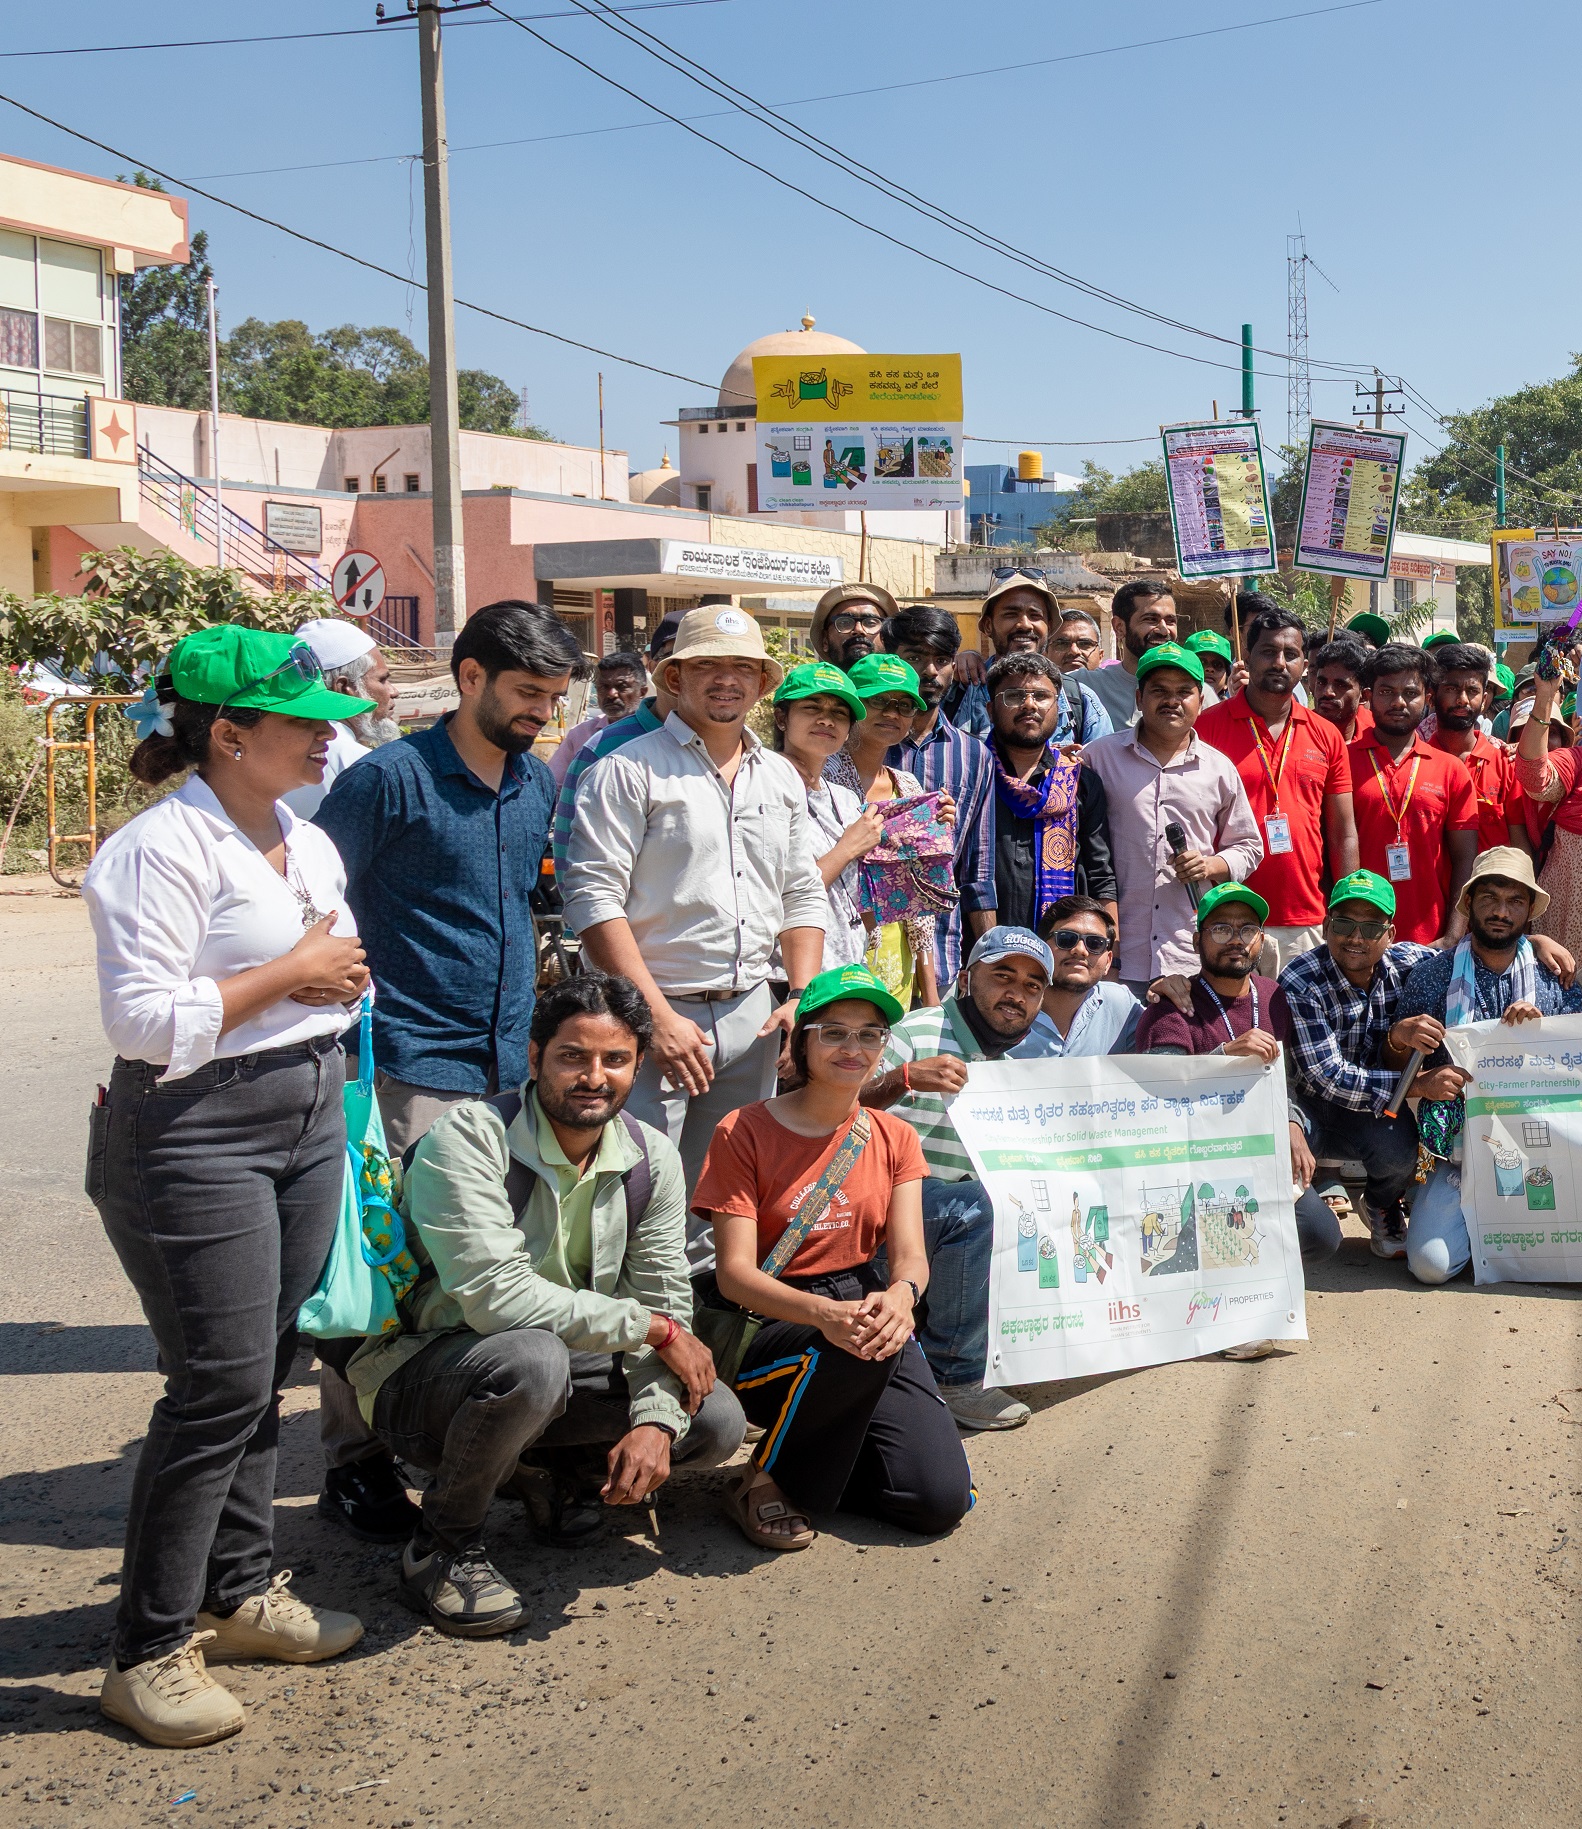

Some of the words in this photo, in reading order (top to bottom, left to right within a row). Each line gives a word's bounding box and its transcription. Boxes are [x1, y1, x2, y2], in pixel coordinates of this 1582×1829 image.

[1542, 549, 1556, 559] SAY
[1558, 549, 1572, 559] NO!
[1477, 1054, 1524, 1069] ನಗರಸಭೆ
[1529, 1054, 1556, 1071] ಮತ್ತು
[1478, 1080, 1528, 1091] City-Farmer
[1531, 1077, 1580, 1089] Partnership
[1008, 1106, 1031, 1125] ಮತ್ತು
[1034, 1101, 1063, 1127] ರೈತರ
[1068, 1097, 1136, 1120] ಸಹಭಾಗಿತ್ವದಲ್ಲಿ
[1140, 1096, 1159, 1110] ಘನ
[1163, 1095, 1195, 1117] ತ್ಯಾಜ್ಯ
[1199, 1089, 1246, 1106] ನಿರ್ವಹಣೆ
[1054, 1133, 1065, 1143] for
[1066, 1131, 1087, 1142] Solid
[1088, 1129, 1113, 1139] Waste
[1114, 1124, 1168, 1139] Management
[1483, 1230, 1546, 1252] ಚಿಕ್ಕಬಳ್ಳಾಪುರ
[1185, 1291, 1223, 1325] Godrej
[1229, 1292, 1274, 1306] PROPERTIES
[1108, 1300, 1141, 1321] iihs
[1001, 1314, 1049, 1343] ಚಿಕ್ಕಬಳ್ಳಾಪುರ
[1052, 1310, 1085, 1329] ನಗರಸಭೆ
